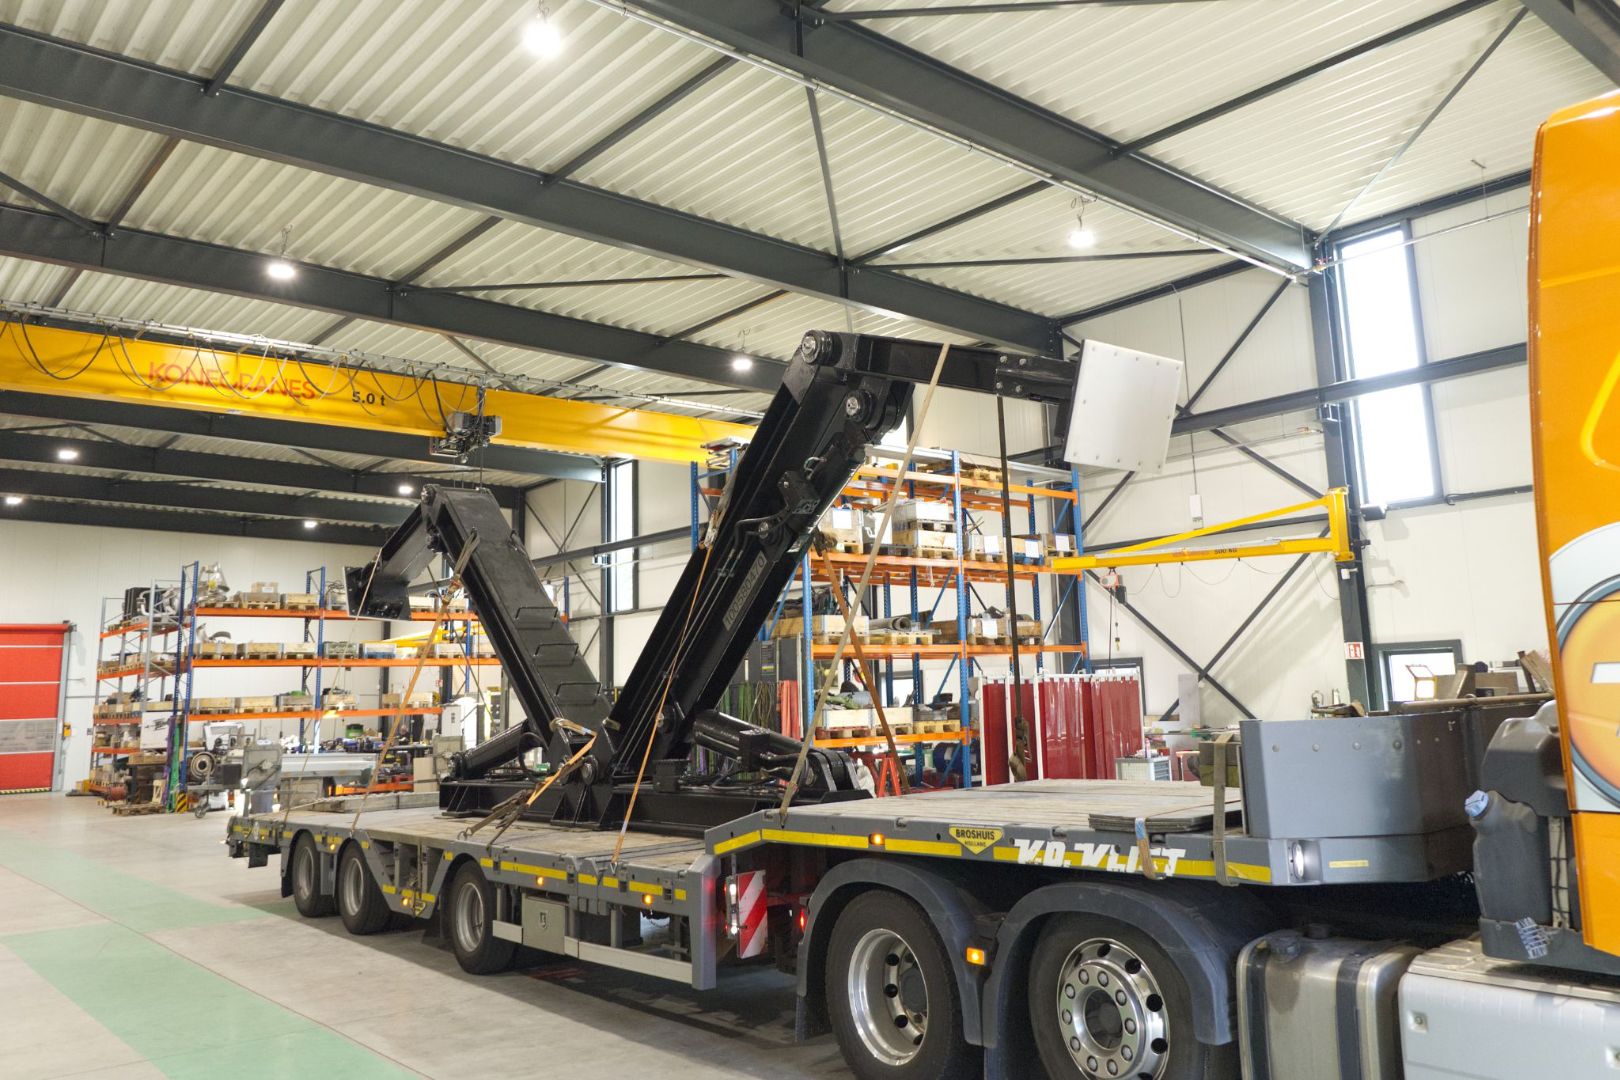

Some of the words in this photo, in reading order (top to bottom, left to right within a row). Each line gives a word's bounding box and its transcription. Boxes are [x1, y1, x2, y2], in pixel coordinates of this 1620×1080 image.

[149, 362, 316, 399] KONECRANES
[352, 391, 375, 404] 5.0
[380, 394, 385, 406] t
[955, 829, 995, 840] BROSHUIS
